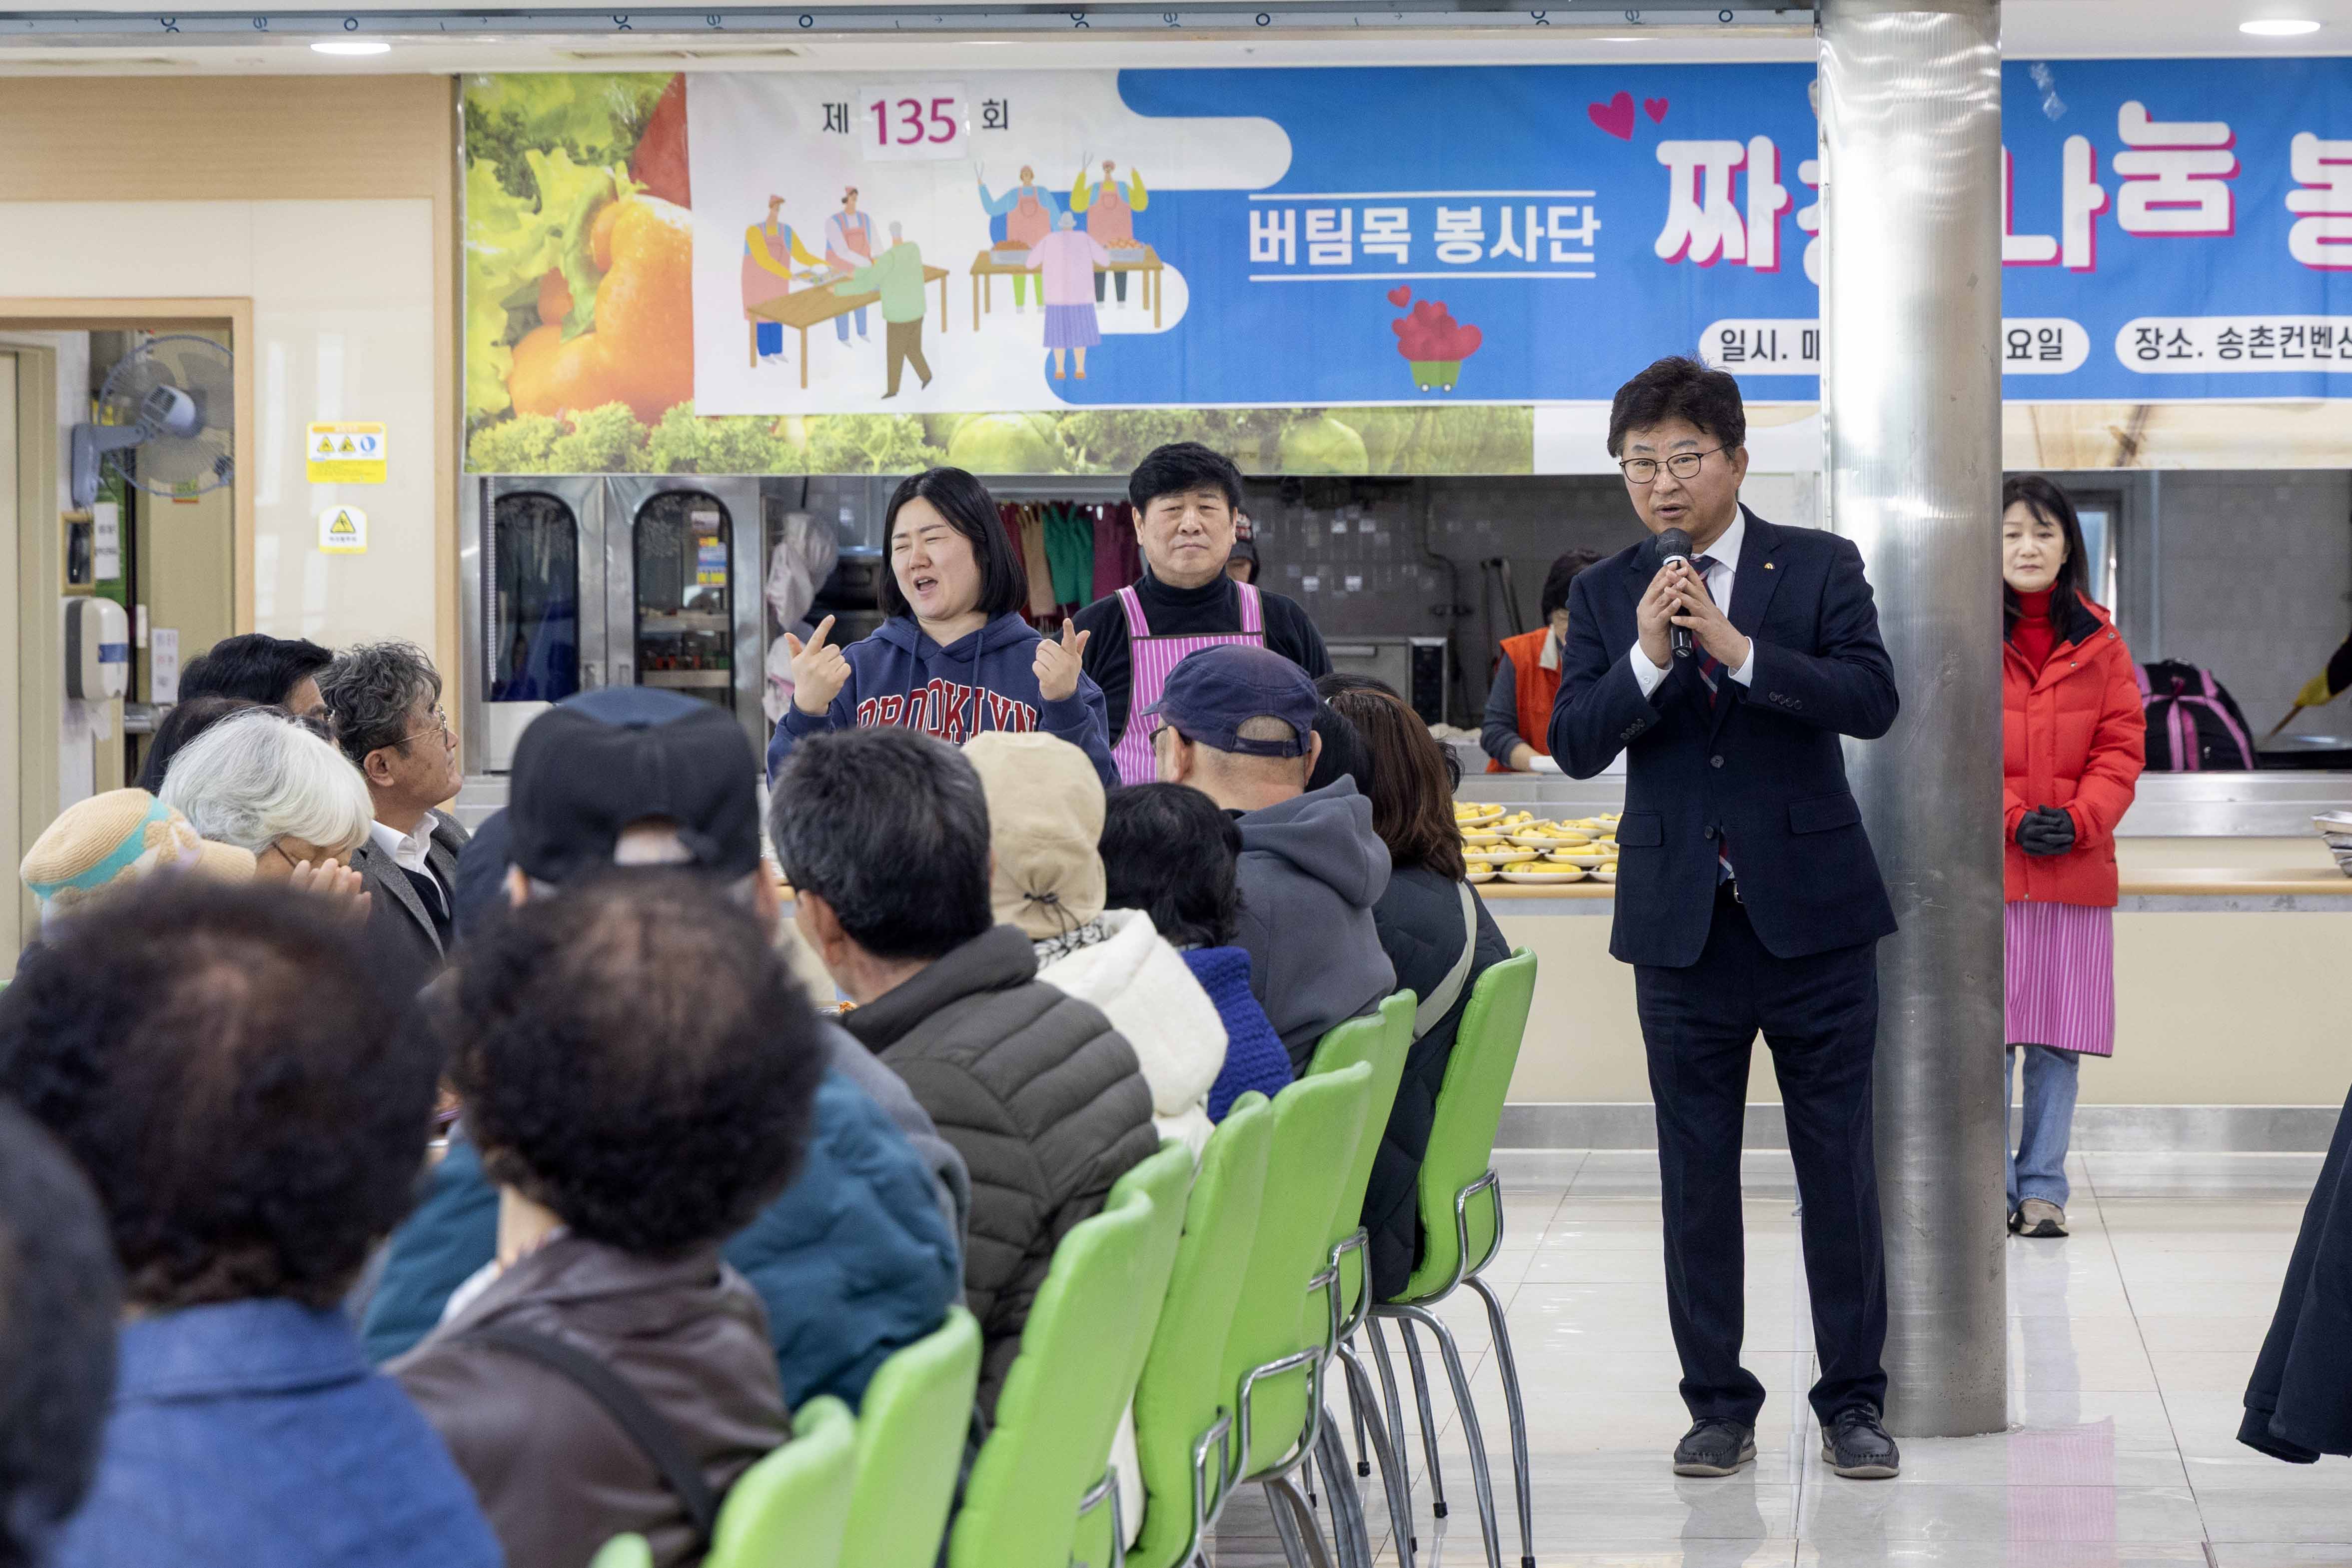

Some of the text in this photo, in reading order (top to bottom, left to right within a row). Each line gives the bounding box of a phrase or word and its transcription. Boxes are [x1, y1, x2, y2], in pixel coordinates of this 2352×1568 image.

[822, 98, 1008, 145] 제 135 회
[1654, 135, 1820, 286] 짜
[1249, 205, 1601, 265] 버팀목 봉사단
[1721, 329, 1787, 362] 일시.
[2136, 327, 2203, 360] 장소.
